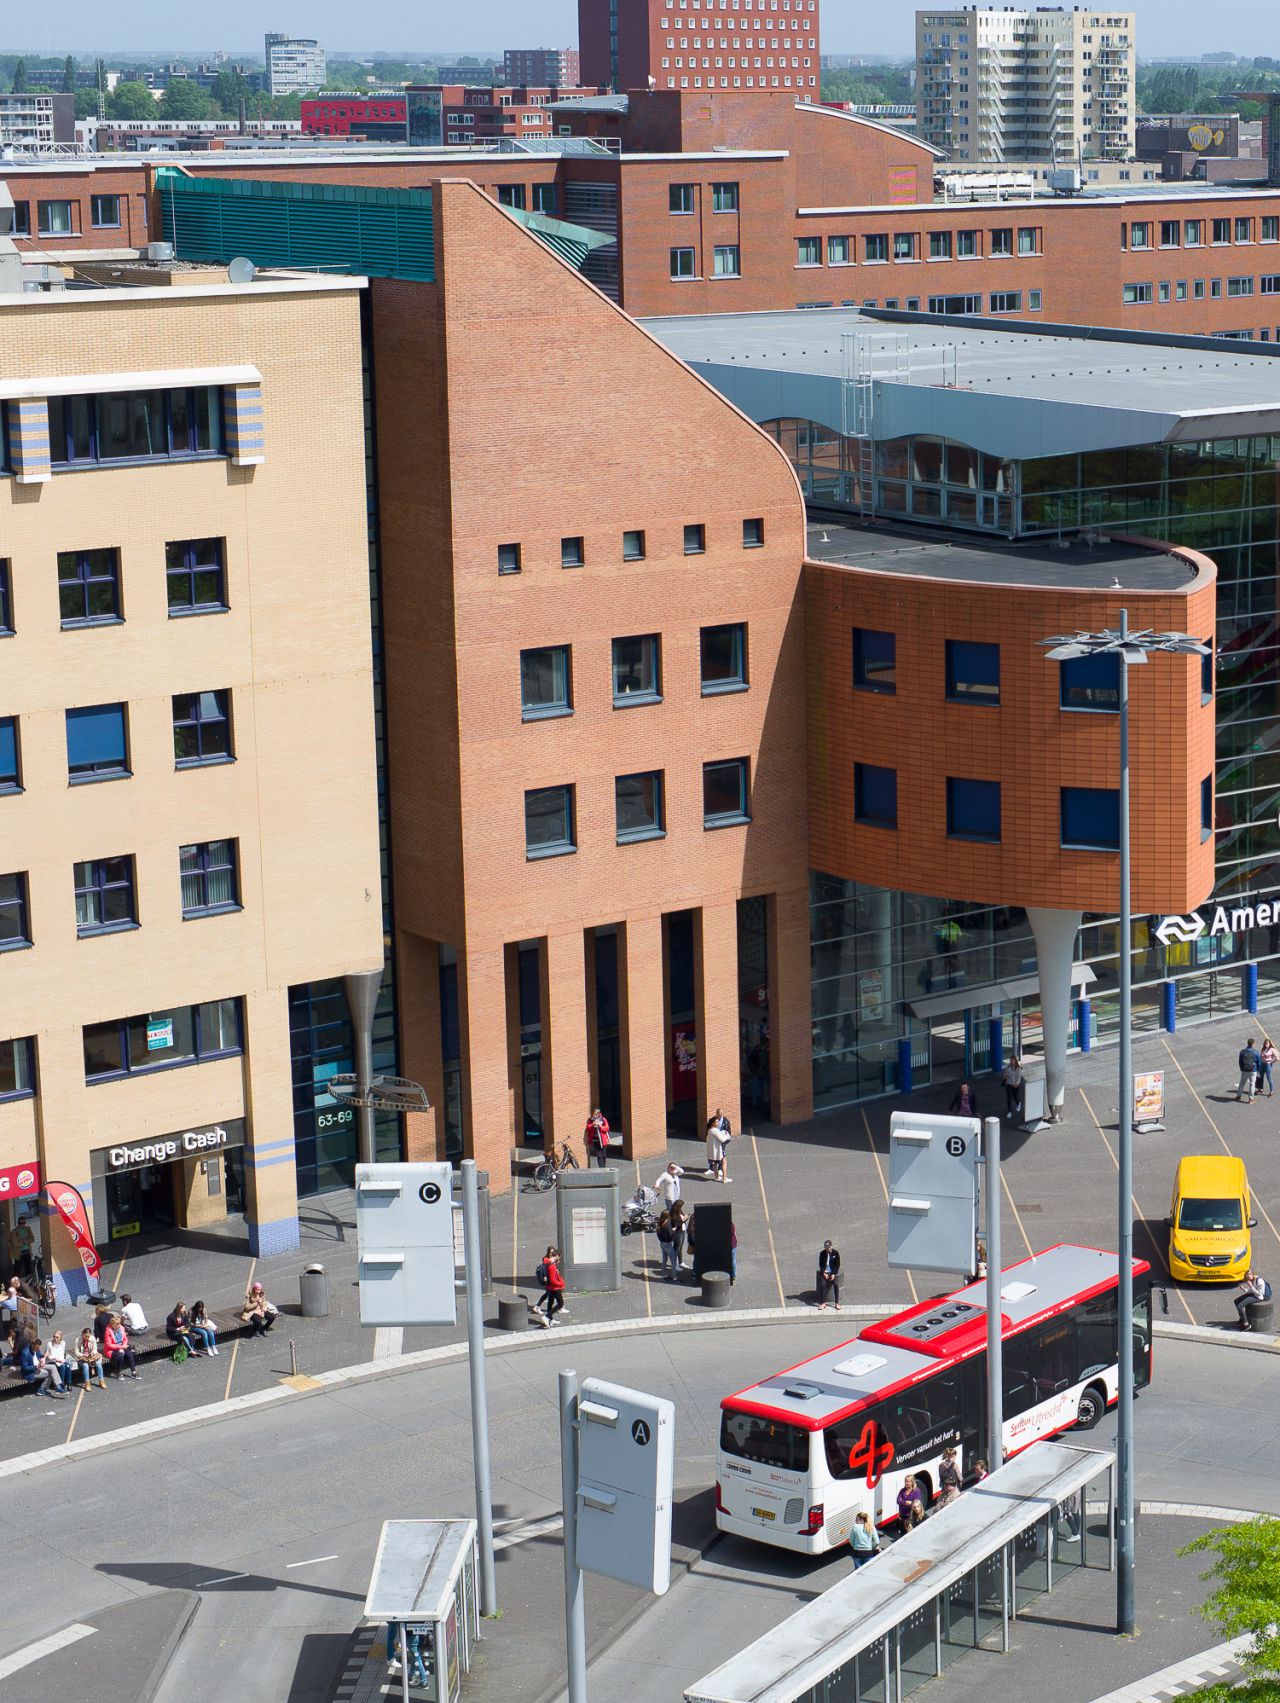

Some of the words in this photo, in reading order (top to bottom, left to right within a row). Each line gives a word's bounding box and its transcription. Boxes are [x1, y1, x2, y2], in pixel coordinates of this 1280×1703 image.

[318, 1110, 353, 1127] 63-69
[109, 1141, 177, 1167] Change
[183, 1126, 227, 1150] Cash
[951, 1138, 963, 1154] B
[423, 1185, 437, 1201] C
[634, 1422, 647, 1443] A
[896, 1448, 916, 1464] Vervoer
[916, 1439, 933, 1454] vanuit
[933, 1434, 943, 1446] het
[942, 1428, 954, 1441] hart
